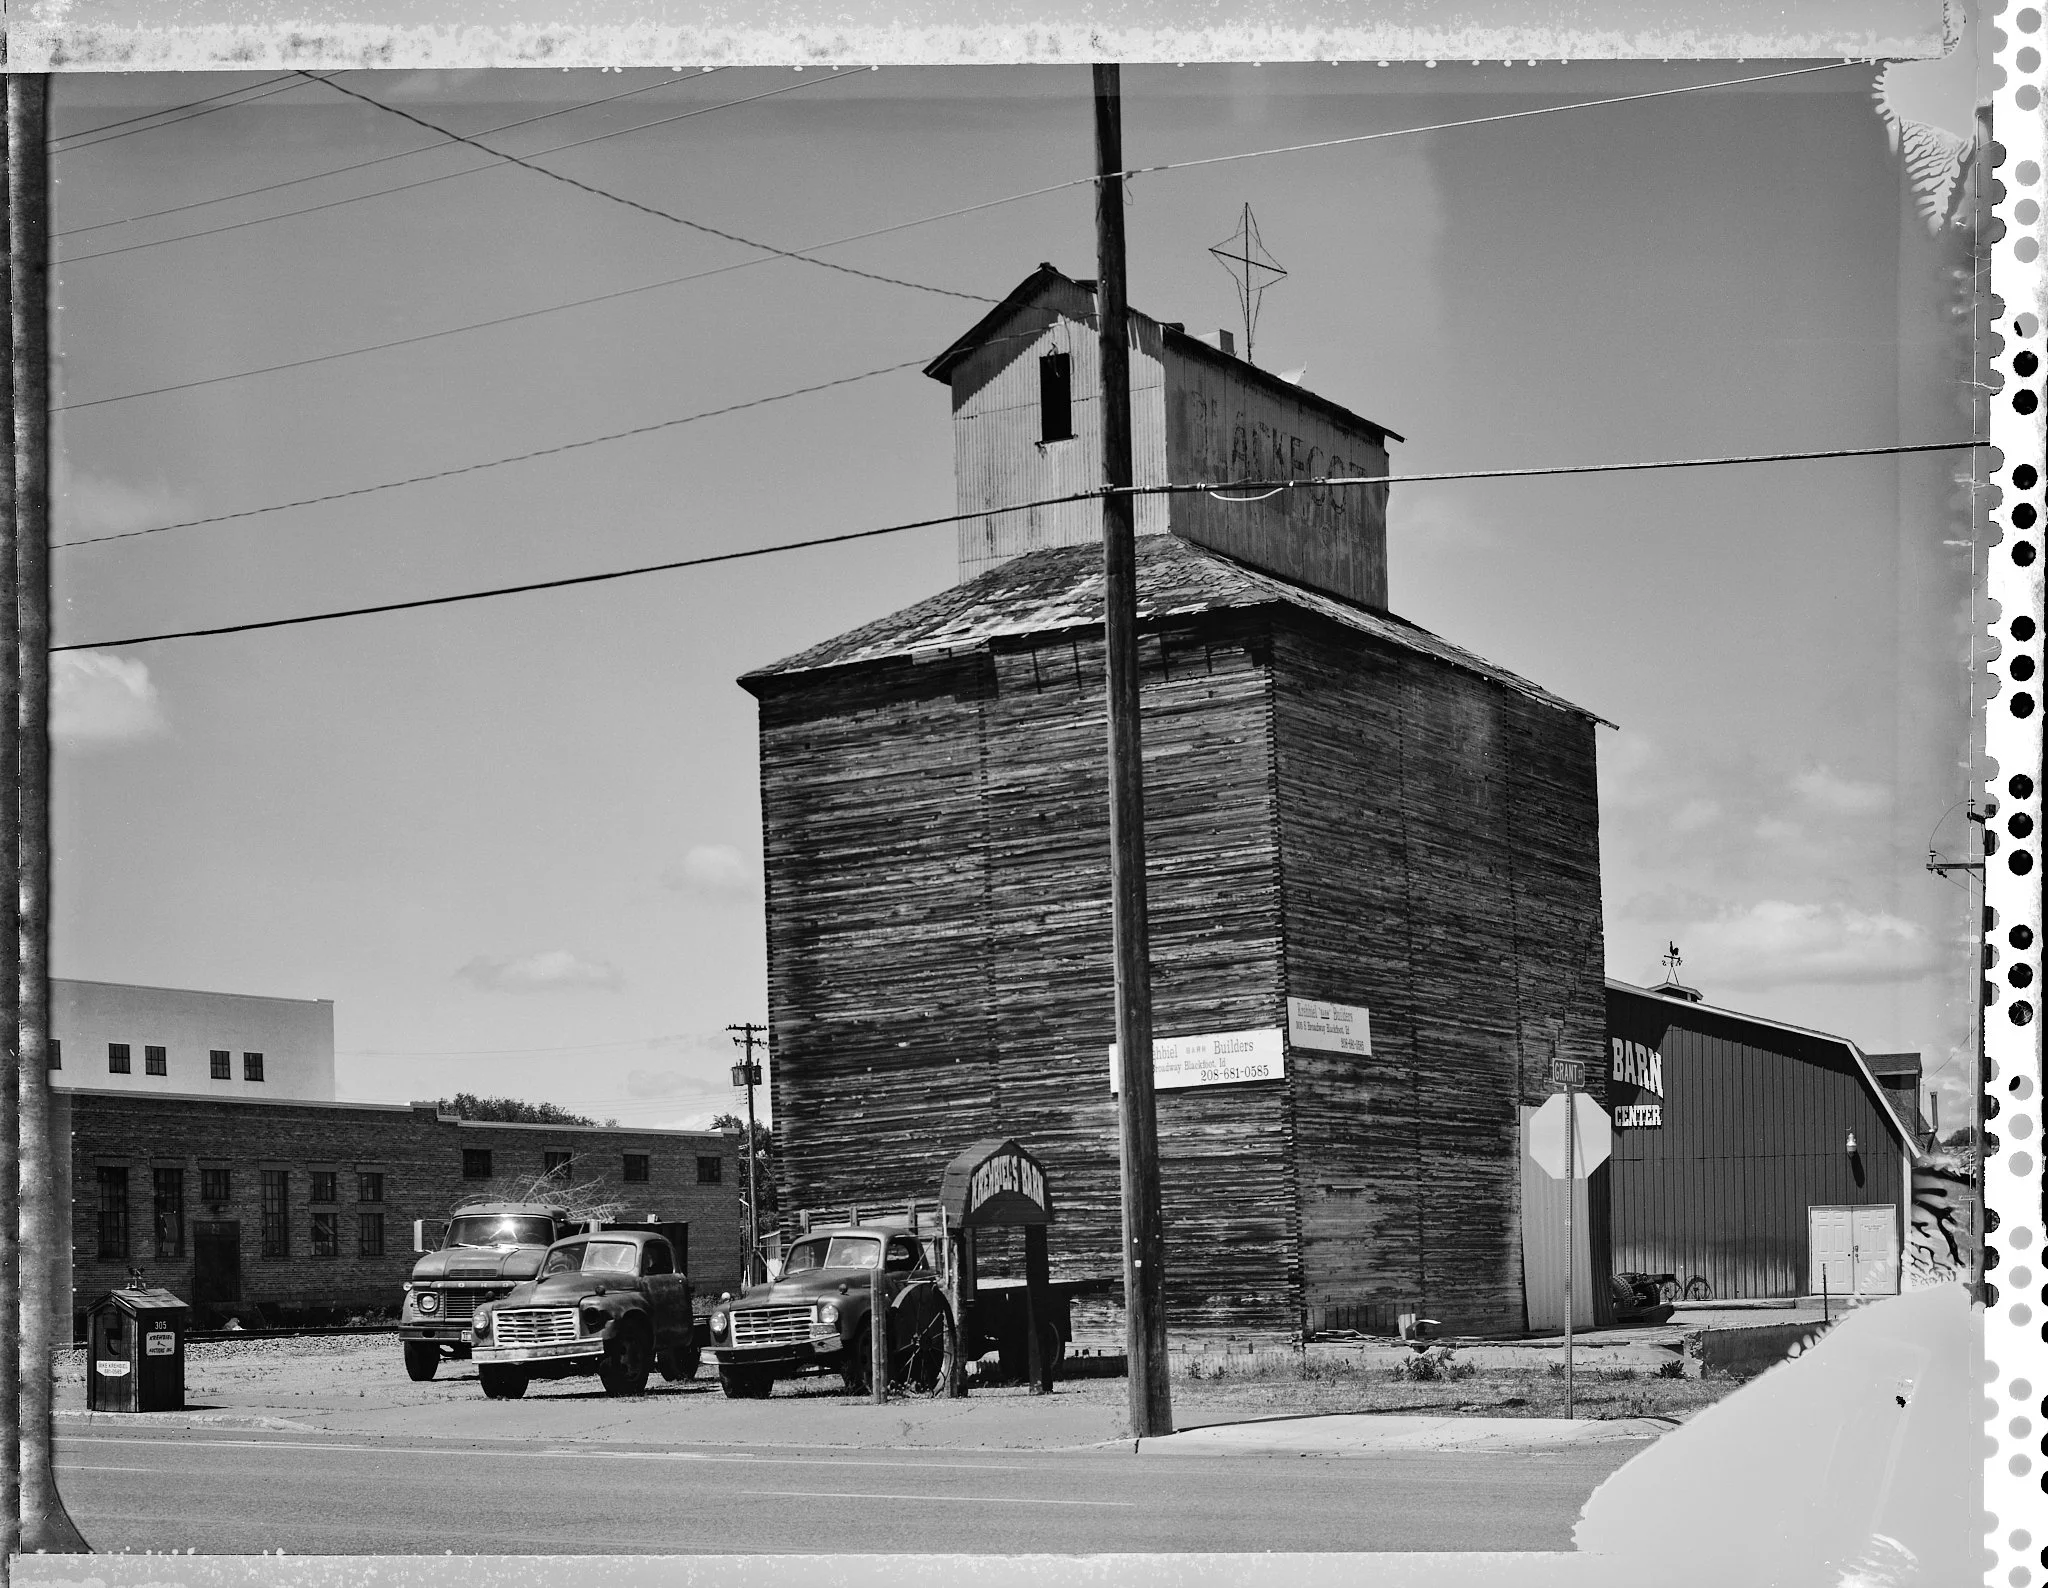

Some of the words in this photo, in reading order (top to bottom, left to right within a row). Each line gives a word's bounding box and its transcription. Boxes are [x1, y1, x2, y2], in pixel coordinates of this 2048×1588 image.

[1332, 1006, 1354, 1023] Builders
[1152, 1043, 1179, 1061] ehbiel
[1213, 1038, 1255, 1055] Builders
[1153, 1062, 1182, 1075] roadway
[1219, 1057, 1227, 1068] Id
[1200, 1065, 1270, 1082] 208-681-0585
[1554, 1061, 1578, 1083] GRANT
[1611, 1037, 1664, 1099] BARN
[1614, 1104, 1662, 1127] CENTER
[1020, 1157, 1045, 1212] BARN
[154, 1320, 167, 1330] 305
